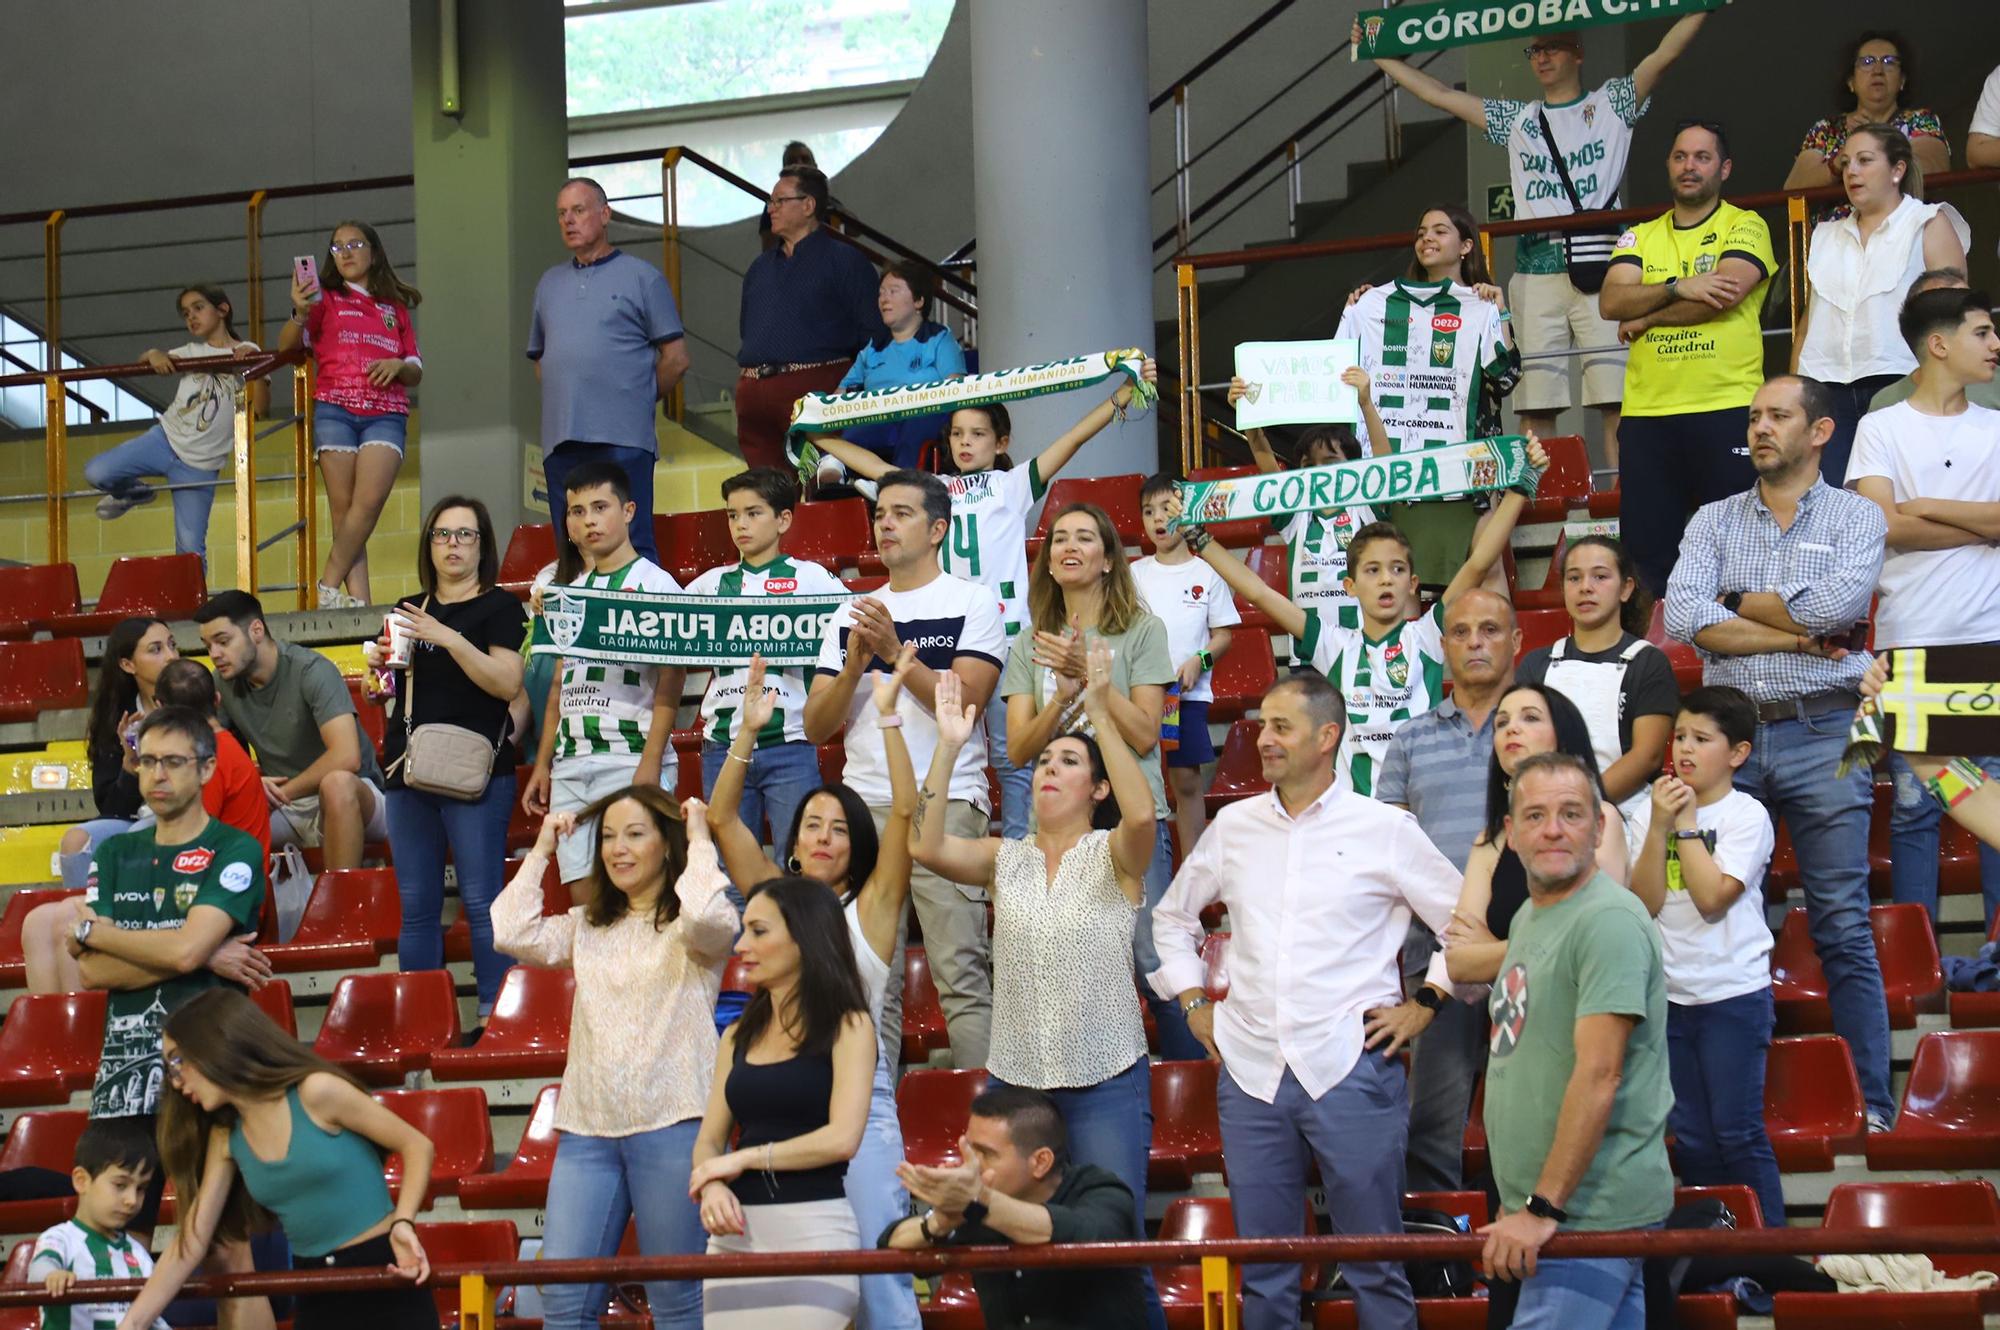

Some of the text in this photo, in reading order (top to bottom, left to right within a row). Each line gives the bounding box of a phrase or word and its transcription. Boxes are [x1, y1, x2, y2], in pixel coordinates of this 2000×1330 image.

[1397, 0, 1592, 45] CÓRDOBA
[1525, 173, 1598, 200] CONTGO
[1657, 340, 1716, 354] Catedral
[1261, 355, 1336, 376] VAMOS
[1409, 374, 1453, 383] PATRIMONIO
[884, 387, 960, 407] PATRIMONIO
[966, 383, 981, 393] DE
[987, 379, 1003, 390] LA
[1010, 365, 1086, 387] HUMANIDAD
[1409, 382, 1456, 391] HUMANIDAD
[957, 397, 990, 407] PRIMERA
[822, 419, 853, 429] PRIMERA
[1253, 456, 1440, 512] CÓRDOBA
[289, 621, 333, 632] FILA
[563, 696, 610, 707] Catedral
[1946, 684, 2000, 712] CÓ
[37, 798, 85, 812] FILA
[535, 1213, 544, 1227] 6
